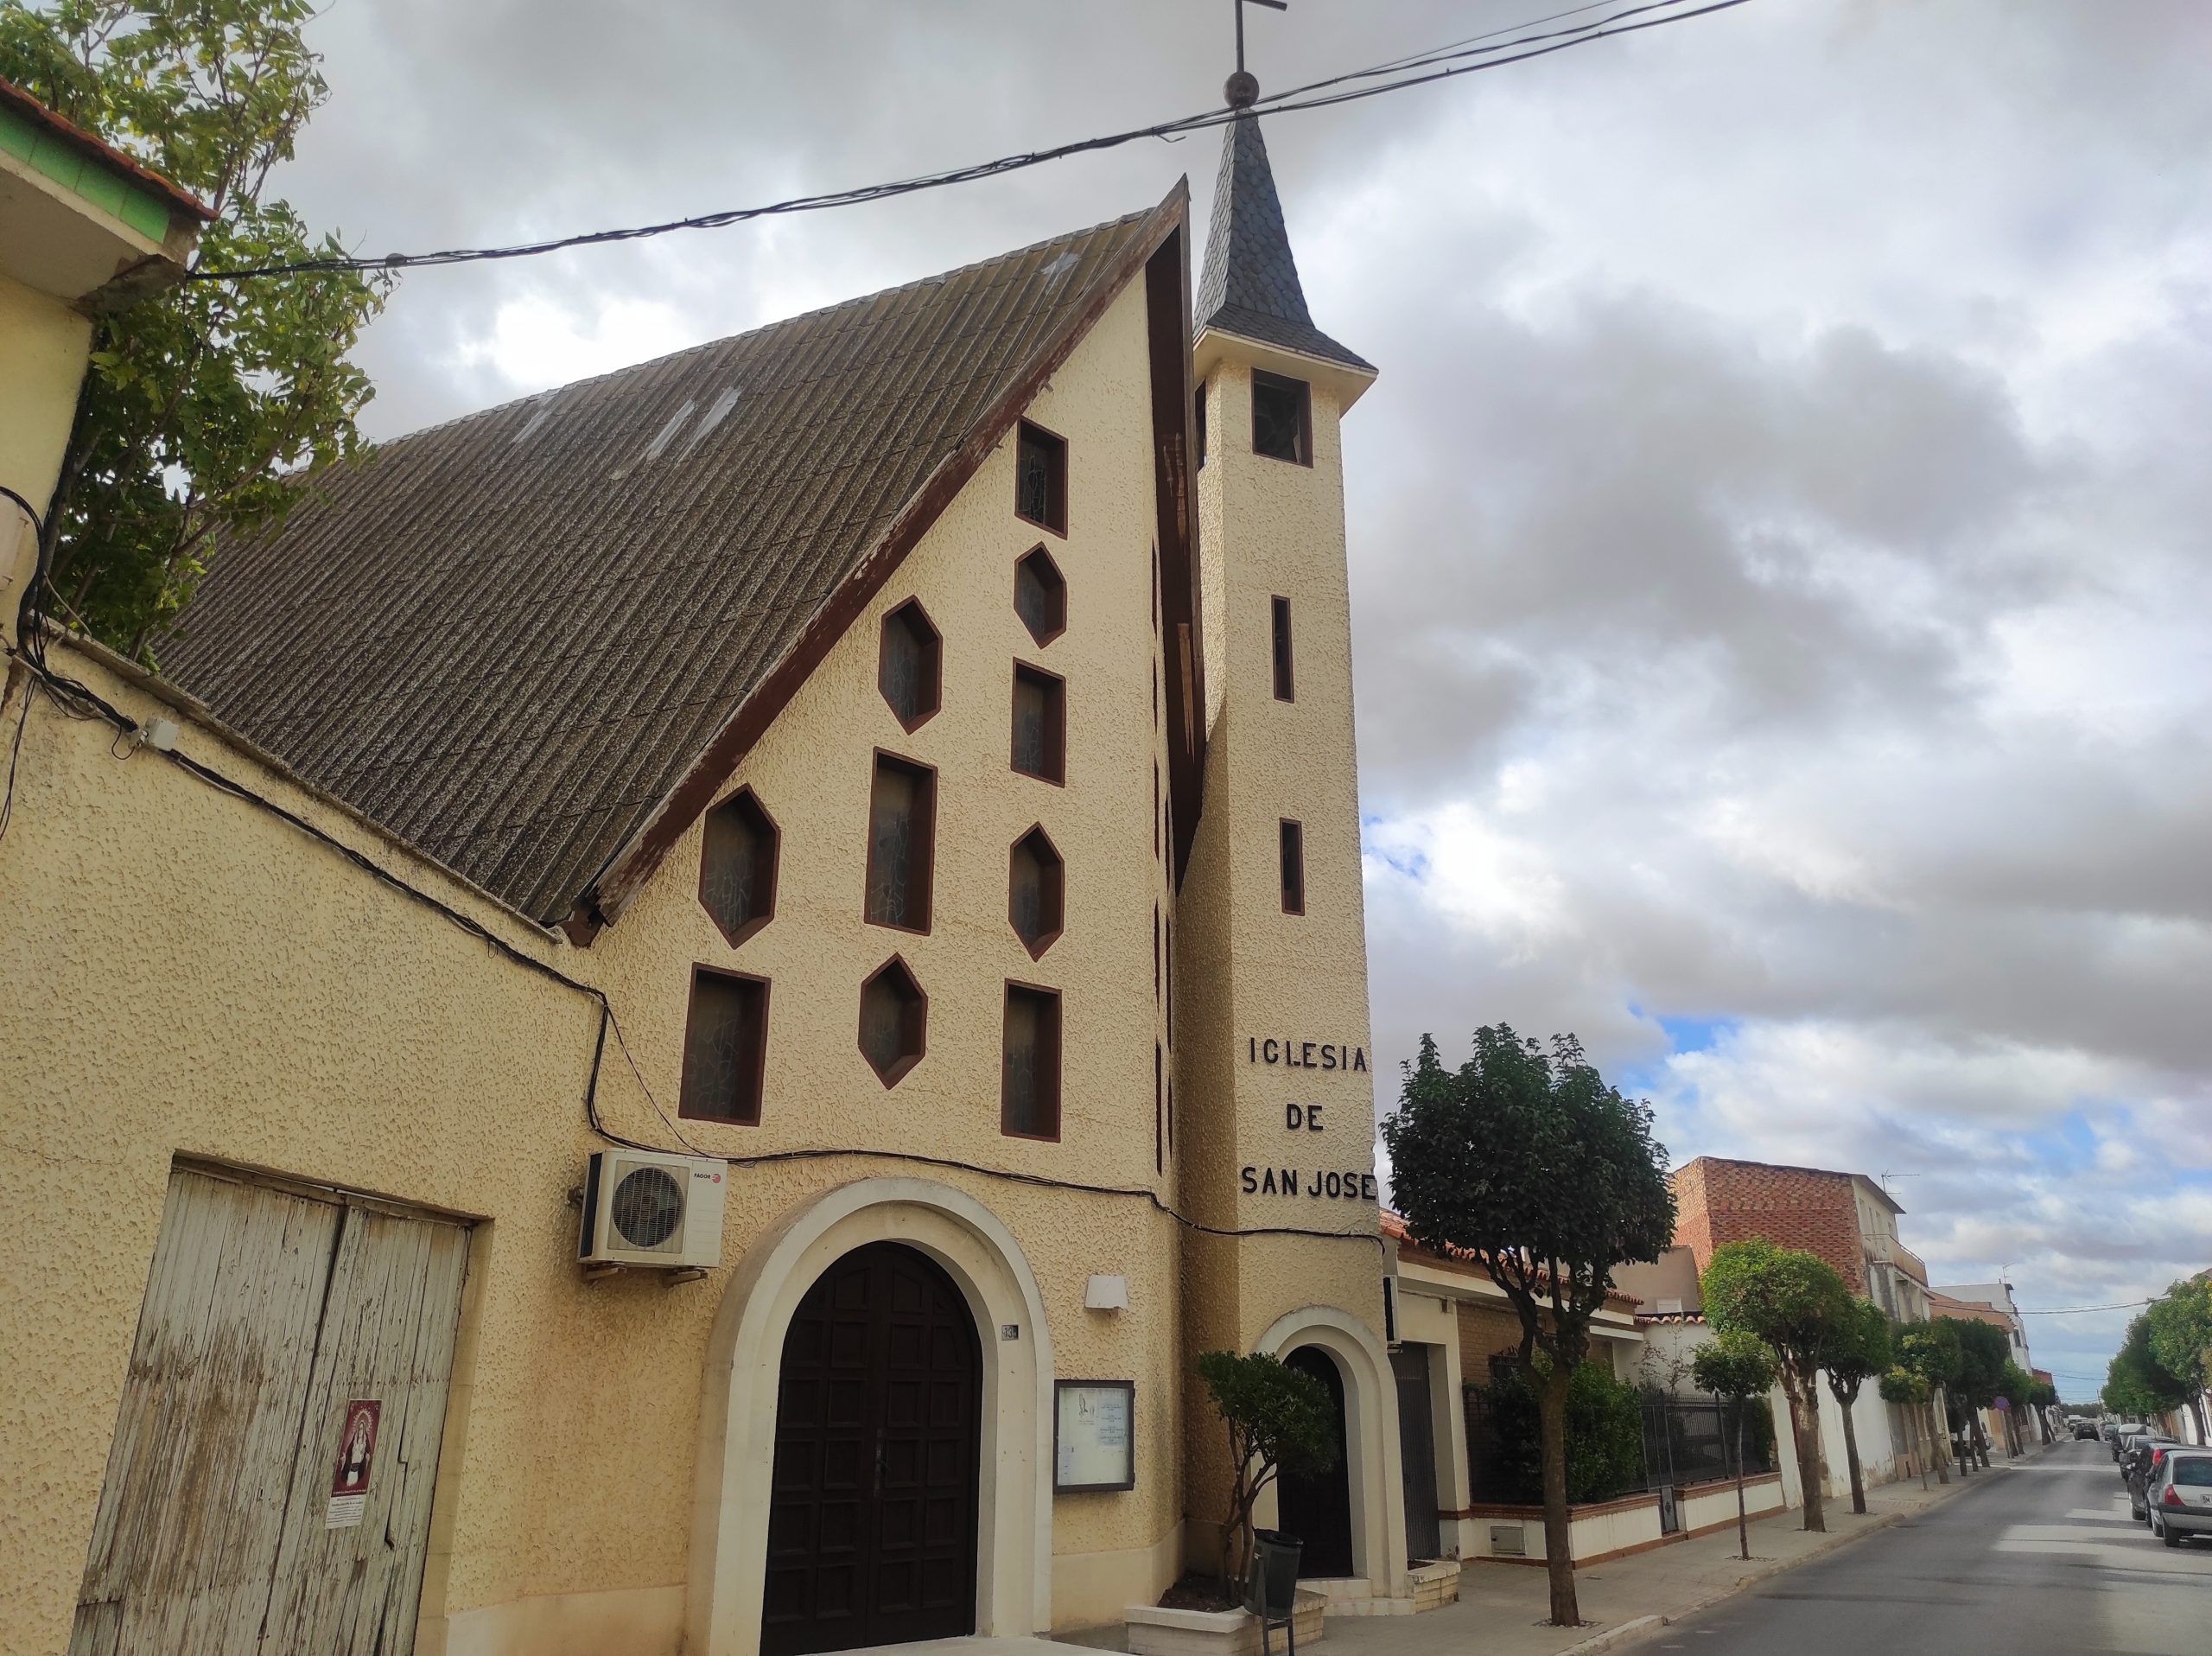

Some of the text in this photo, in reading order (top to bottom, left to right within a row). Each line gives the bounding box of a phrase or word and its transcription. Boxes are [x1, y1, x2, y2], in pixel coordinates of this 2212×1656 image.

[1250, 1037, 1368, 1072] IGLESIA
[1287, 1103, 1324, 1131] DE
[1242, 1167, 1376, 1201] SAN JOSE
